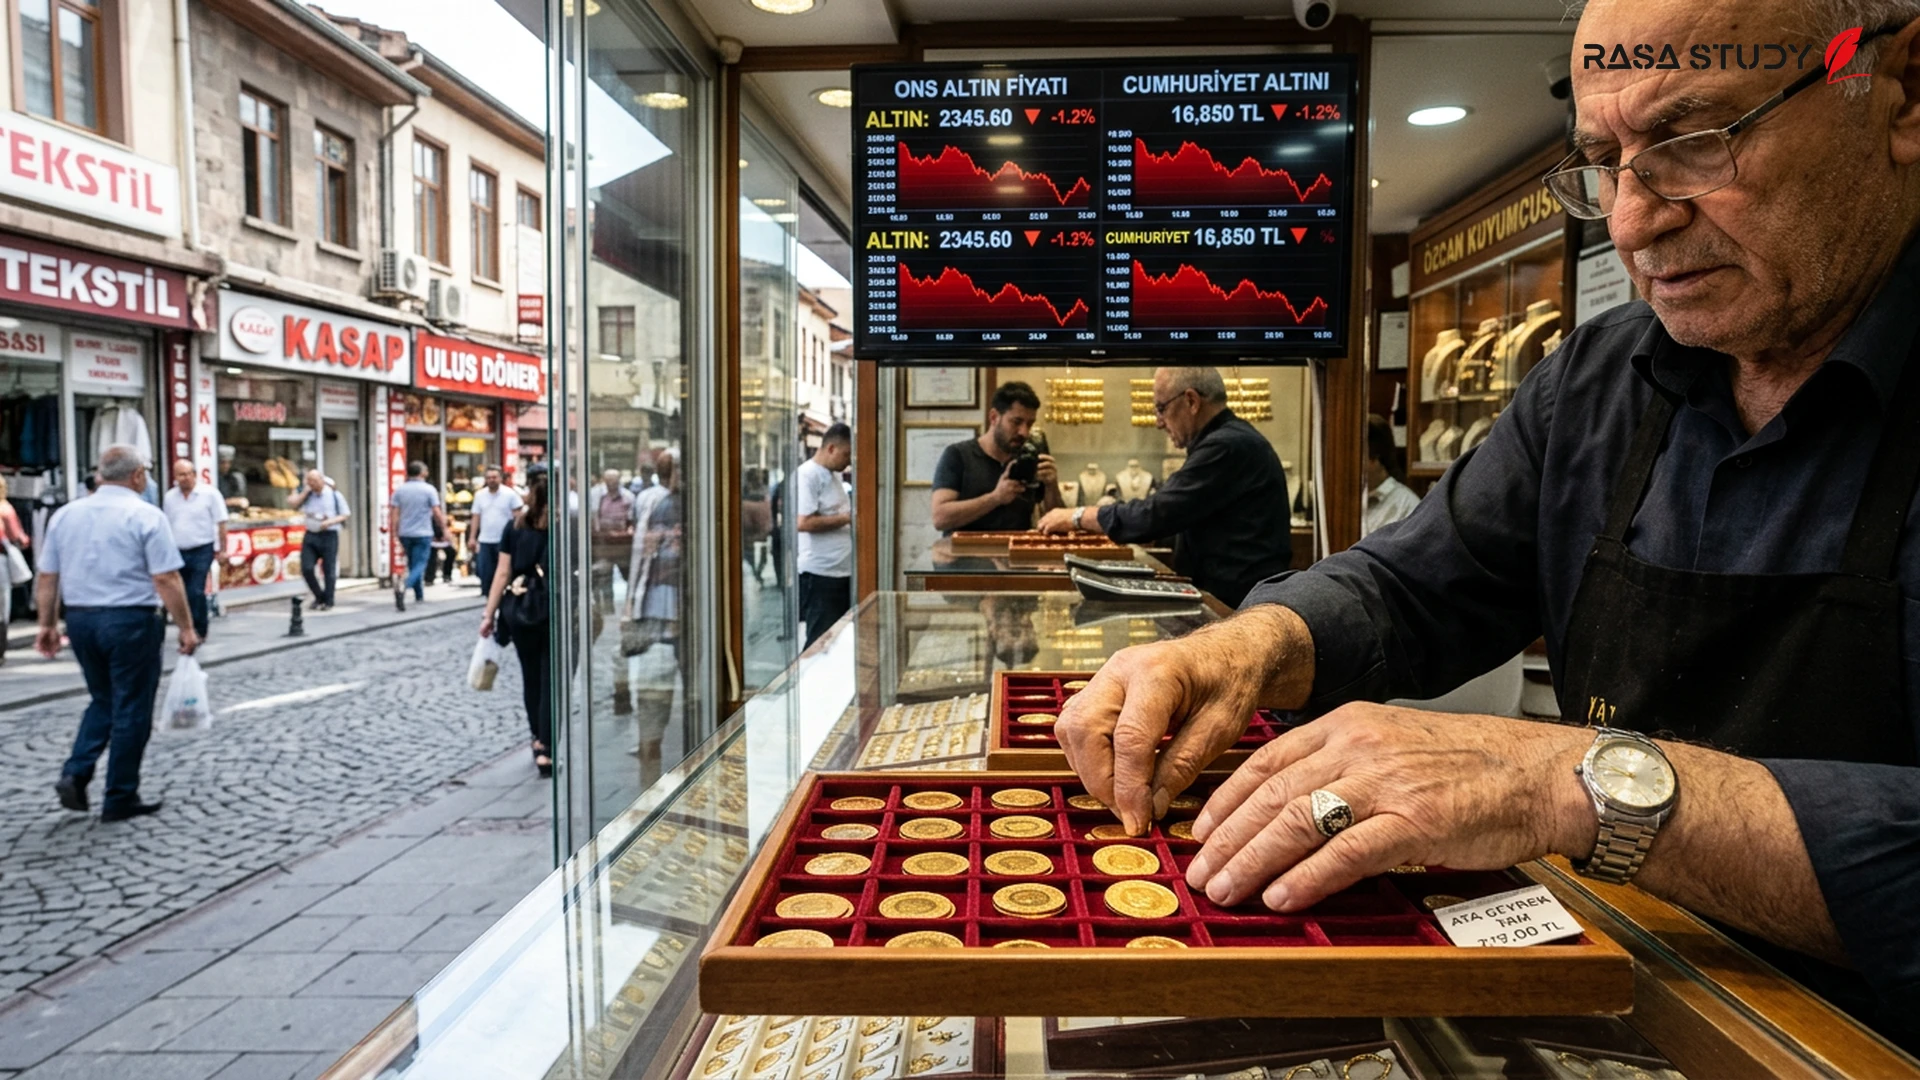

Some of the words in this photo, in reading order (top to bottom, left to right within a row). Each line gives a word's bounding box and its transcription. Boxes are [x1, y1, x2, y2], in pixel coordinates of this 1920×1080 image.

[894, 79, 938, 98] ONS
[942, 77, 1000, 98] ALTIN
[1006, 74, 1068, 97] FİYATI
[1122, 69, 1260, 94] CUMHURİYET
[1263, 71, 1330, 92] ALTINI
[865, 110, 929, 129] ALTIN:
[939, 108, 1013, 128] 2345.60
[1050, 108, 1096, 125] -1.2%
[1171, 104, 1235, 126] 16,850
[1239, 103, 1265, 122] TL
[1295, 104, 1341, 121] -1.2%
[865, 231, 930, 249] ALTIN:
[939, 230, 1013, 249] 2345.60
[1050, 231, 1096, 247] -1.2%
[1105, 228, 1190, 245] CUMHURİYET
[1193, 227, 1255, 249] 16,850
[1260, 227, 1286, 245] TL
[283, 314, 404, 373] KASAP
[424, 345, 478, 383] ULUS
[481, 352, 540, 393] DÖNER
[1452, 912, 1483, 926] ATA
[1495, 913, 1532, 928] TAM
[1541, 921, 1565, 932] TL
